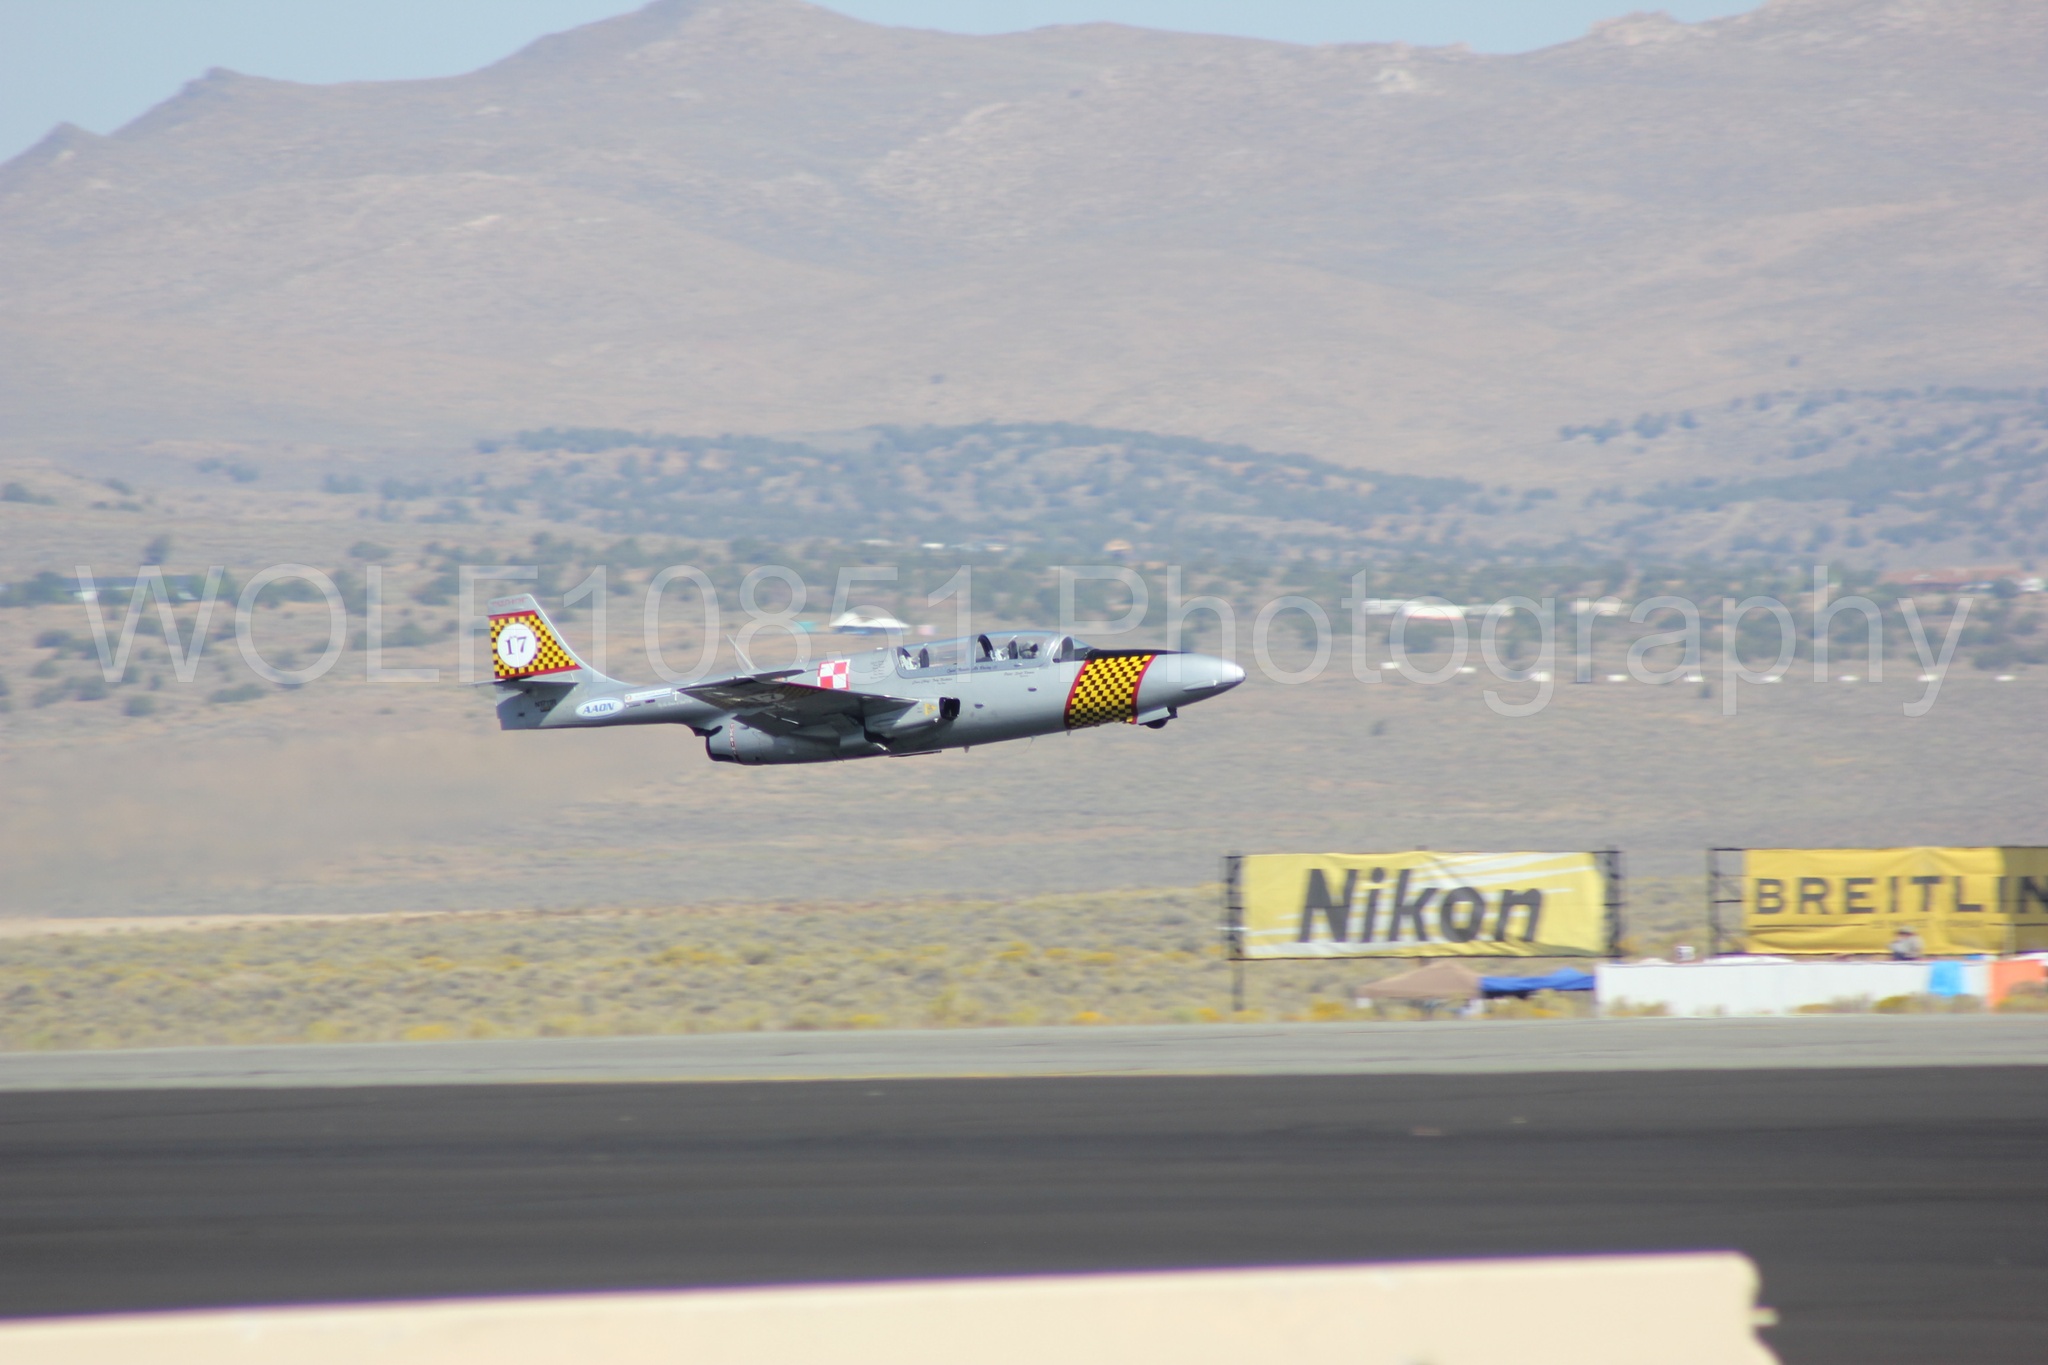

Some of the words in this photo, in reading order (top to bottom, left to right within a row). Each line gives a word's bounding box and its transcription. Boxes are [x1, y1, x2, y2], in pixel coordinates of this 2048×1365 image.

[506, 636, 527, 655] 17
[583, 702, 615, 714] AAON
[1300, 867, 1544, 942] Nikon
